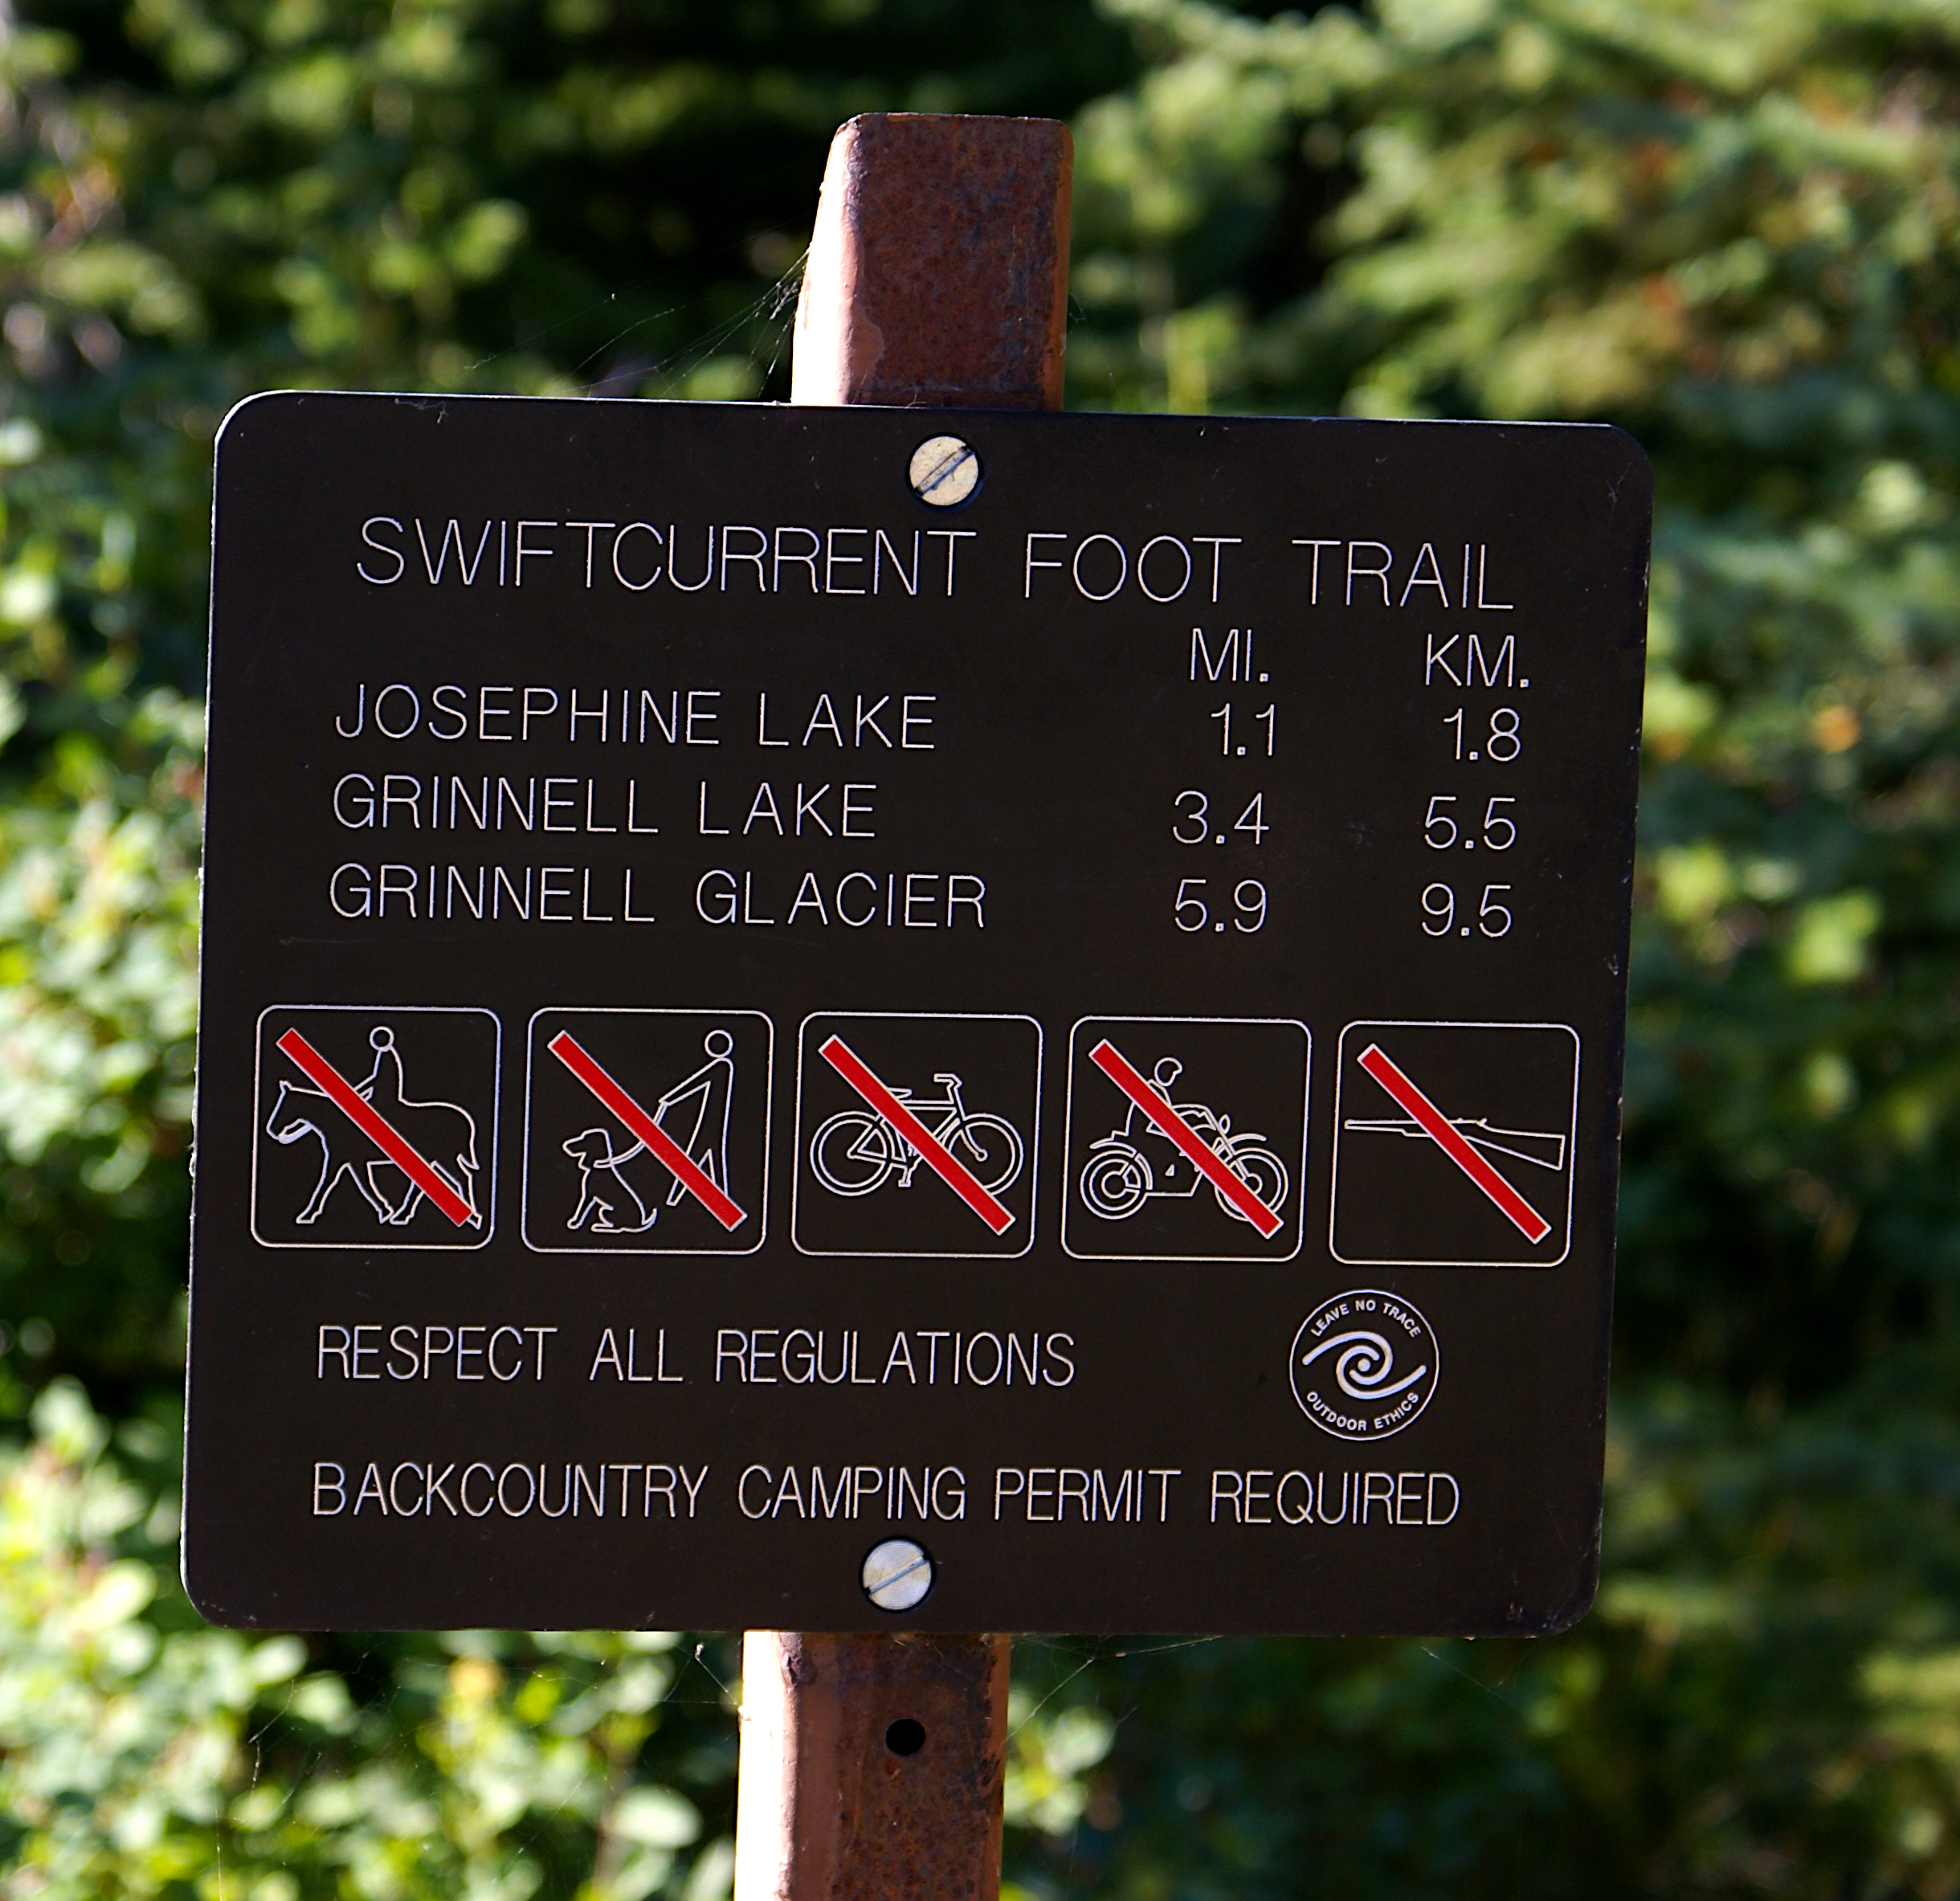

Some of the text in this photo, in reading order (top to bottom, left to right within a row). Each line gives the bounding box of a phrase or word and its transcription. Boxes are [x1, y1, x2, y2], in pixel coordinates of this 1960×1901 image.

[357, 517, 1513, 609] SWIFTCURRENT FOOT TRAIL
[1190, 628, 1529, 688] MI. KM.
[336, 685, 1520, 761] JOSEPHINE LAKE 1.1 1.8
[334, 774, 1515, 849] GRINNELL LAKE 3.4 5.5
[330, 863, 1511, 937] GRINNELL GLACIER 5.9 9.5
[1310, 1299, 1421, 1338] LEAVE NO TRACE
[318, 1326, 1074, 1386] RESPECT ALL REGULATIONS
[1306, 1391, 1419, 1431] OUTDOOR ETHICS
[314, 1462, 1459, 1525] BACKCOUNTRY CAMPING PERMIT REQUIRED
